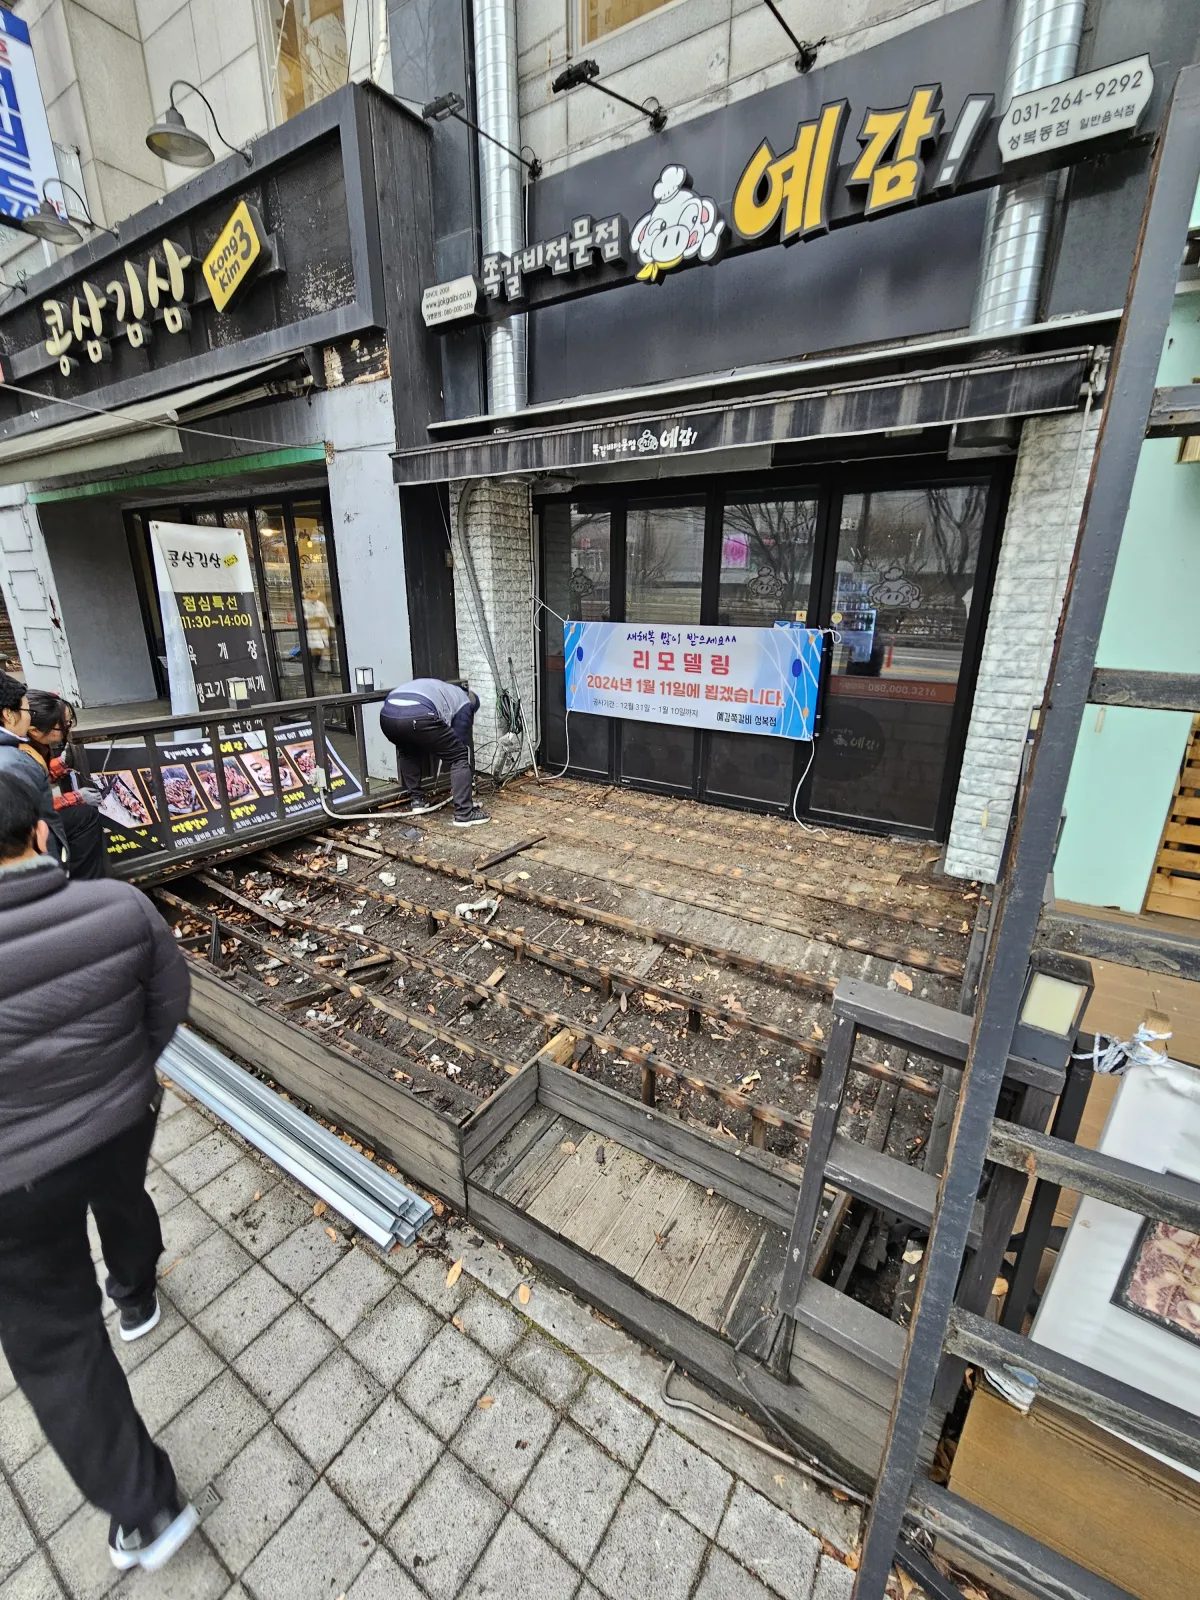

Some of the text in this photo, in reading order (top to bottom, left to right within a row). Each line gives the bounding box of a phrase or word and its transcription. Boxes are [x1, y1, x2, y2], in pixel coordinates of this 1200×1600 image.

[1011, 70, 1144, 125] 031-264-9292
[1007, 104, 1136, 150] 성복동점 일반음식점
[733, 88, 988, 241] 예감!
[209, 219, 253, 281] Kong 3
[484, 217, 619, 299] 쪽갈비전문점
[218, 259, 241, 294] Kim
[660, 426, 698, 448] 예감!
[182, 595, 238, 612] 점심특선
[626, 630, 655, 646] 새해복
[660, 631, 681, 646] 많이
[587, 674, 786, 707] 2024년 1월 11일에 뵙겠습니다.
[867, 683, 937, 697] 080.000.3216
[620, 701, 634, 711] 12월
[635, 702, 651, 713] 31일
[658, 705, 669, 715] 1월
[671, 706, 699, 717] 10일까지
[754, 715, 777, 727] 성복점
